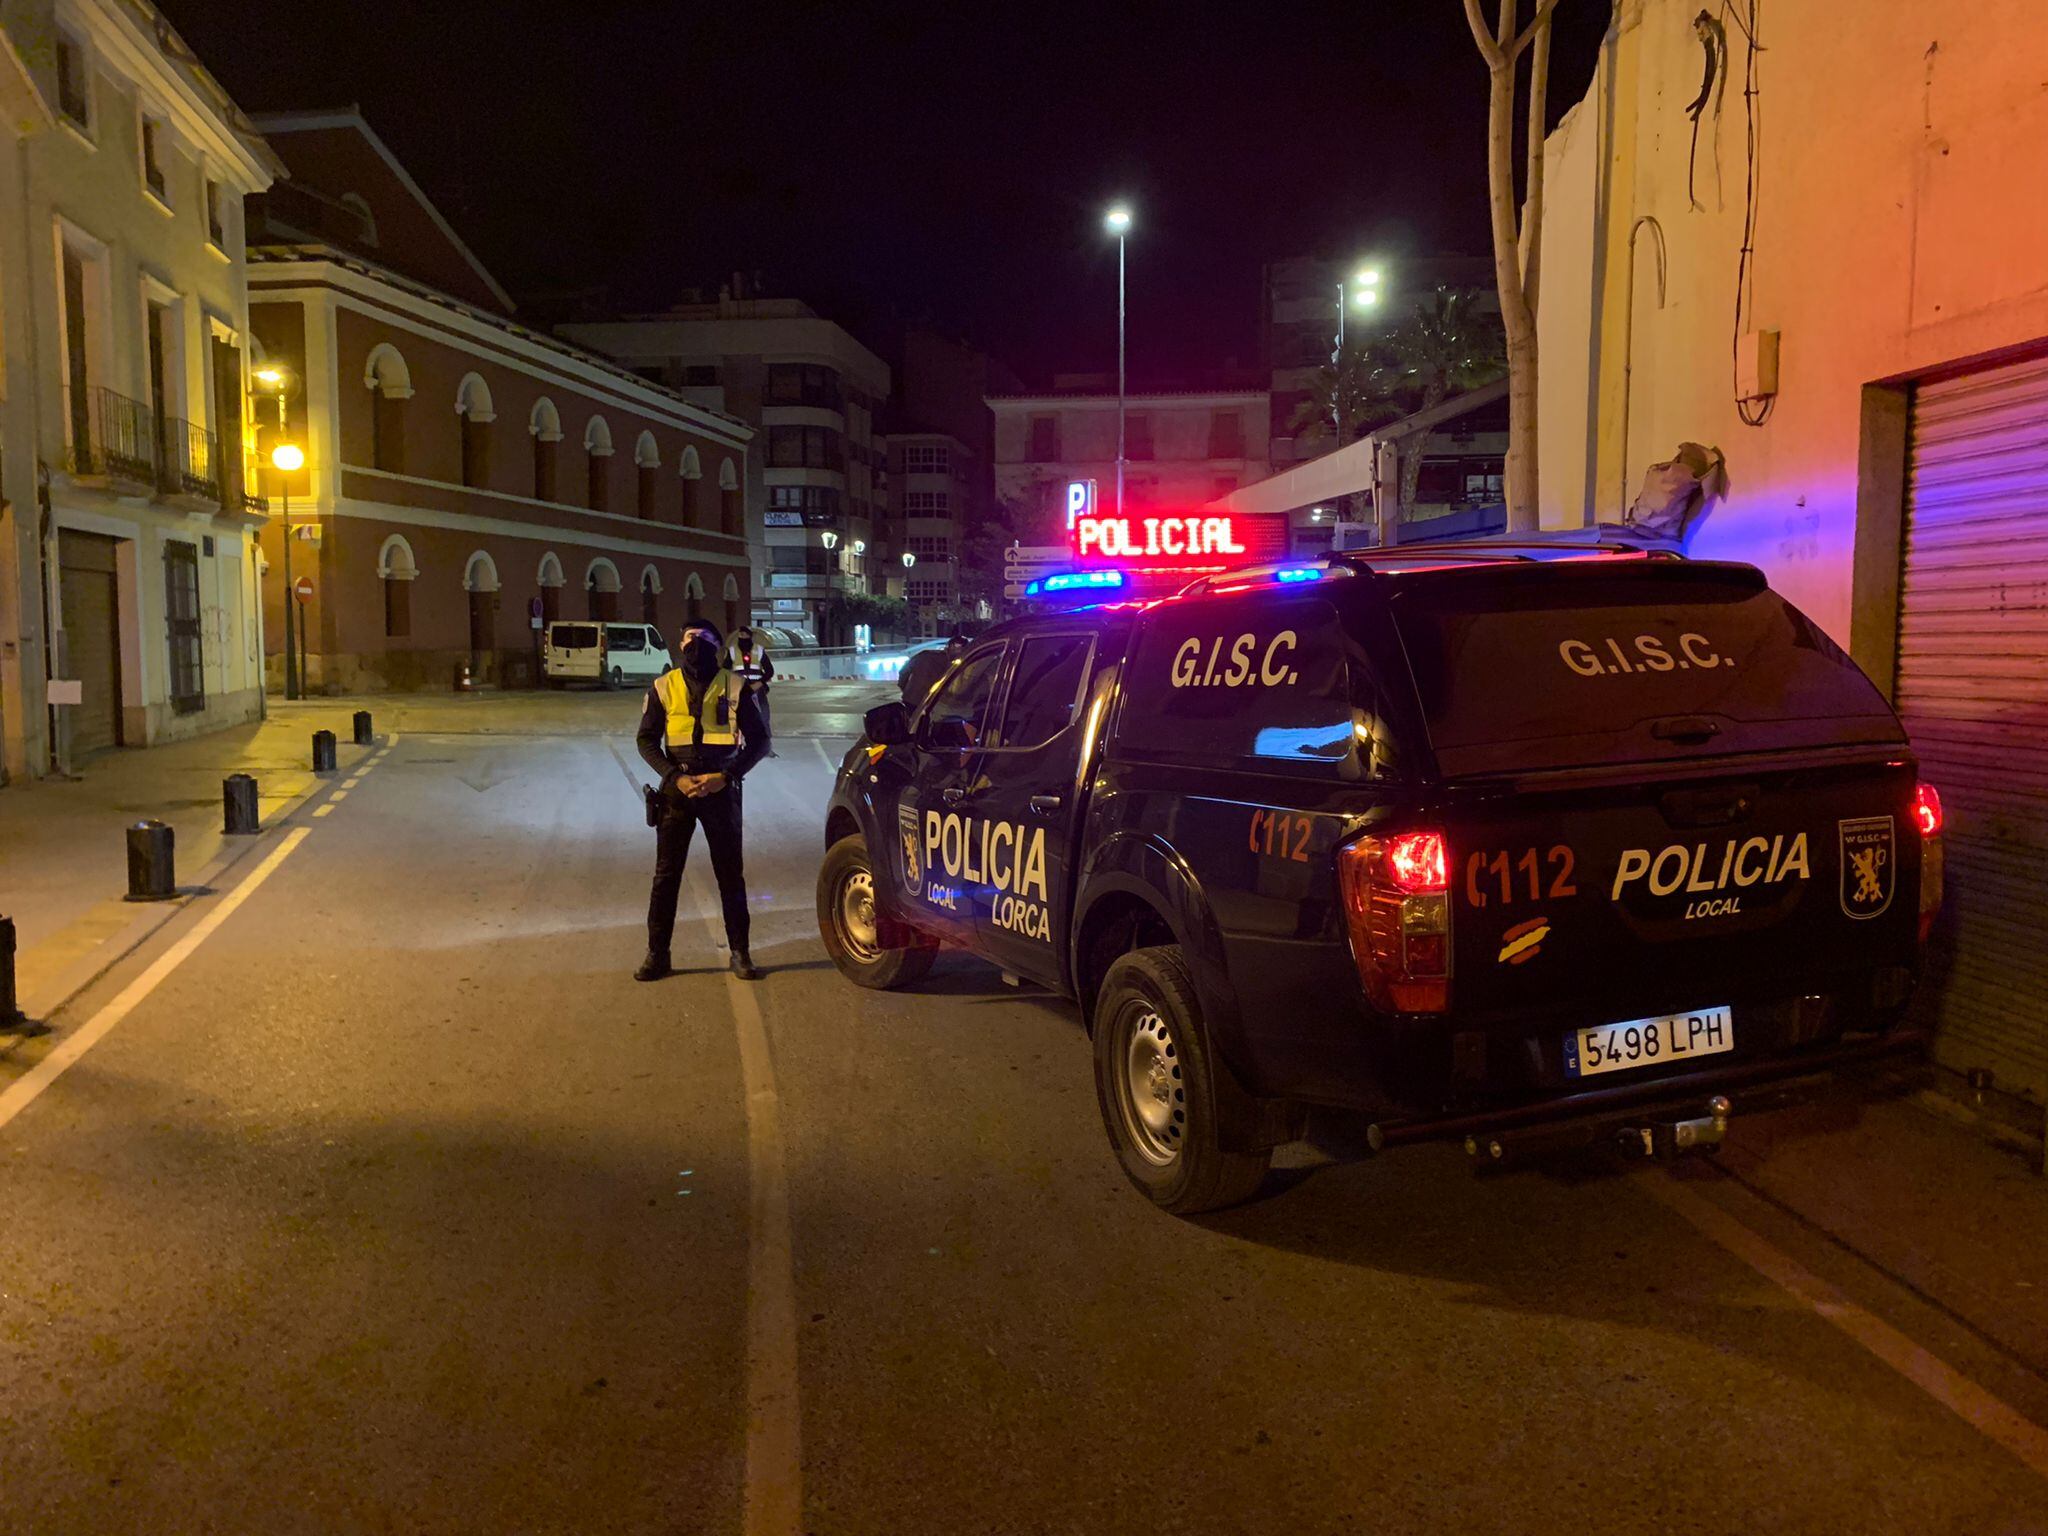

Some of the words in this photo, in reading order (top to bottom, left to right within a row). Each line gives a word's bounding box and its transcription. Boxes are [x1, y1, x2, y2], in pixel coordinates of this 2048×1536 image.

[1067, 483, 1086, 530] P
[1171, 630, 1298, 688] G.I.S.C.
[1559, 633, 1735, 676] G.I.S.C.
[925, 810, 1048, 903] POLICIA
[1262, 810, 1312, 863] 112
[1490, 845, 1577, 903] 112
[1611, 832, 1811, 901] POLICIA
[927, 881, 957, 911] LOCAL
[992, 893, 1051, 943] LORCA
[1685, 897, 1742, 919] LOCAL
[1568, 1058, 1577, 1069] E
[1585, 1024, 1660, 1068] 5498
[1669, 1013, 1724, 1053] LPH
